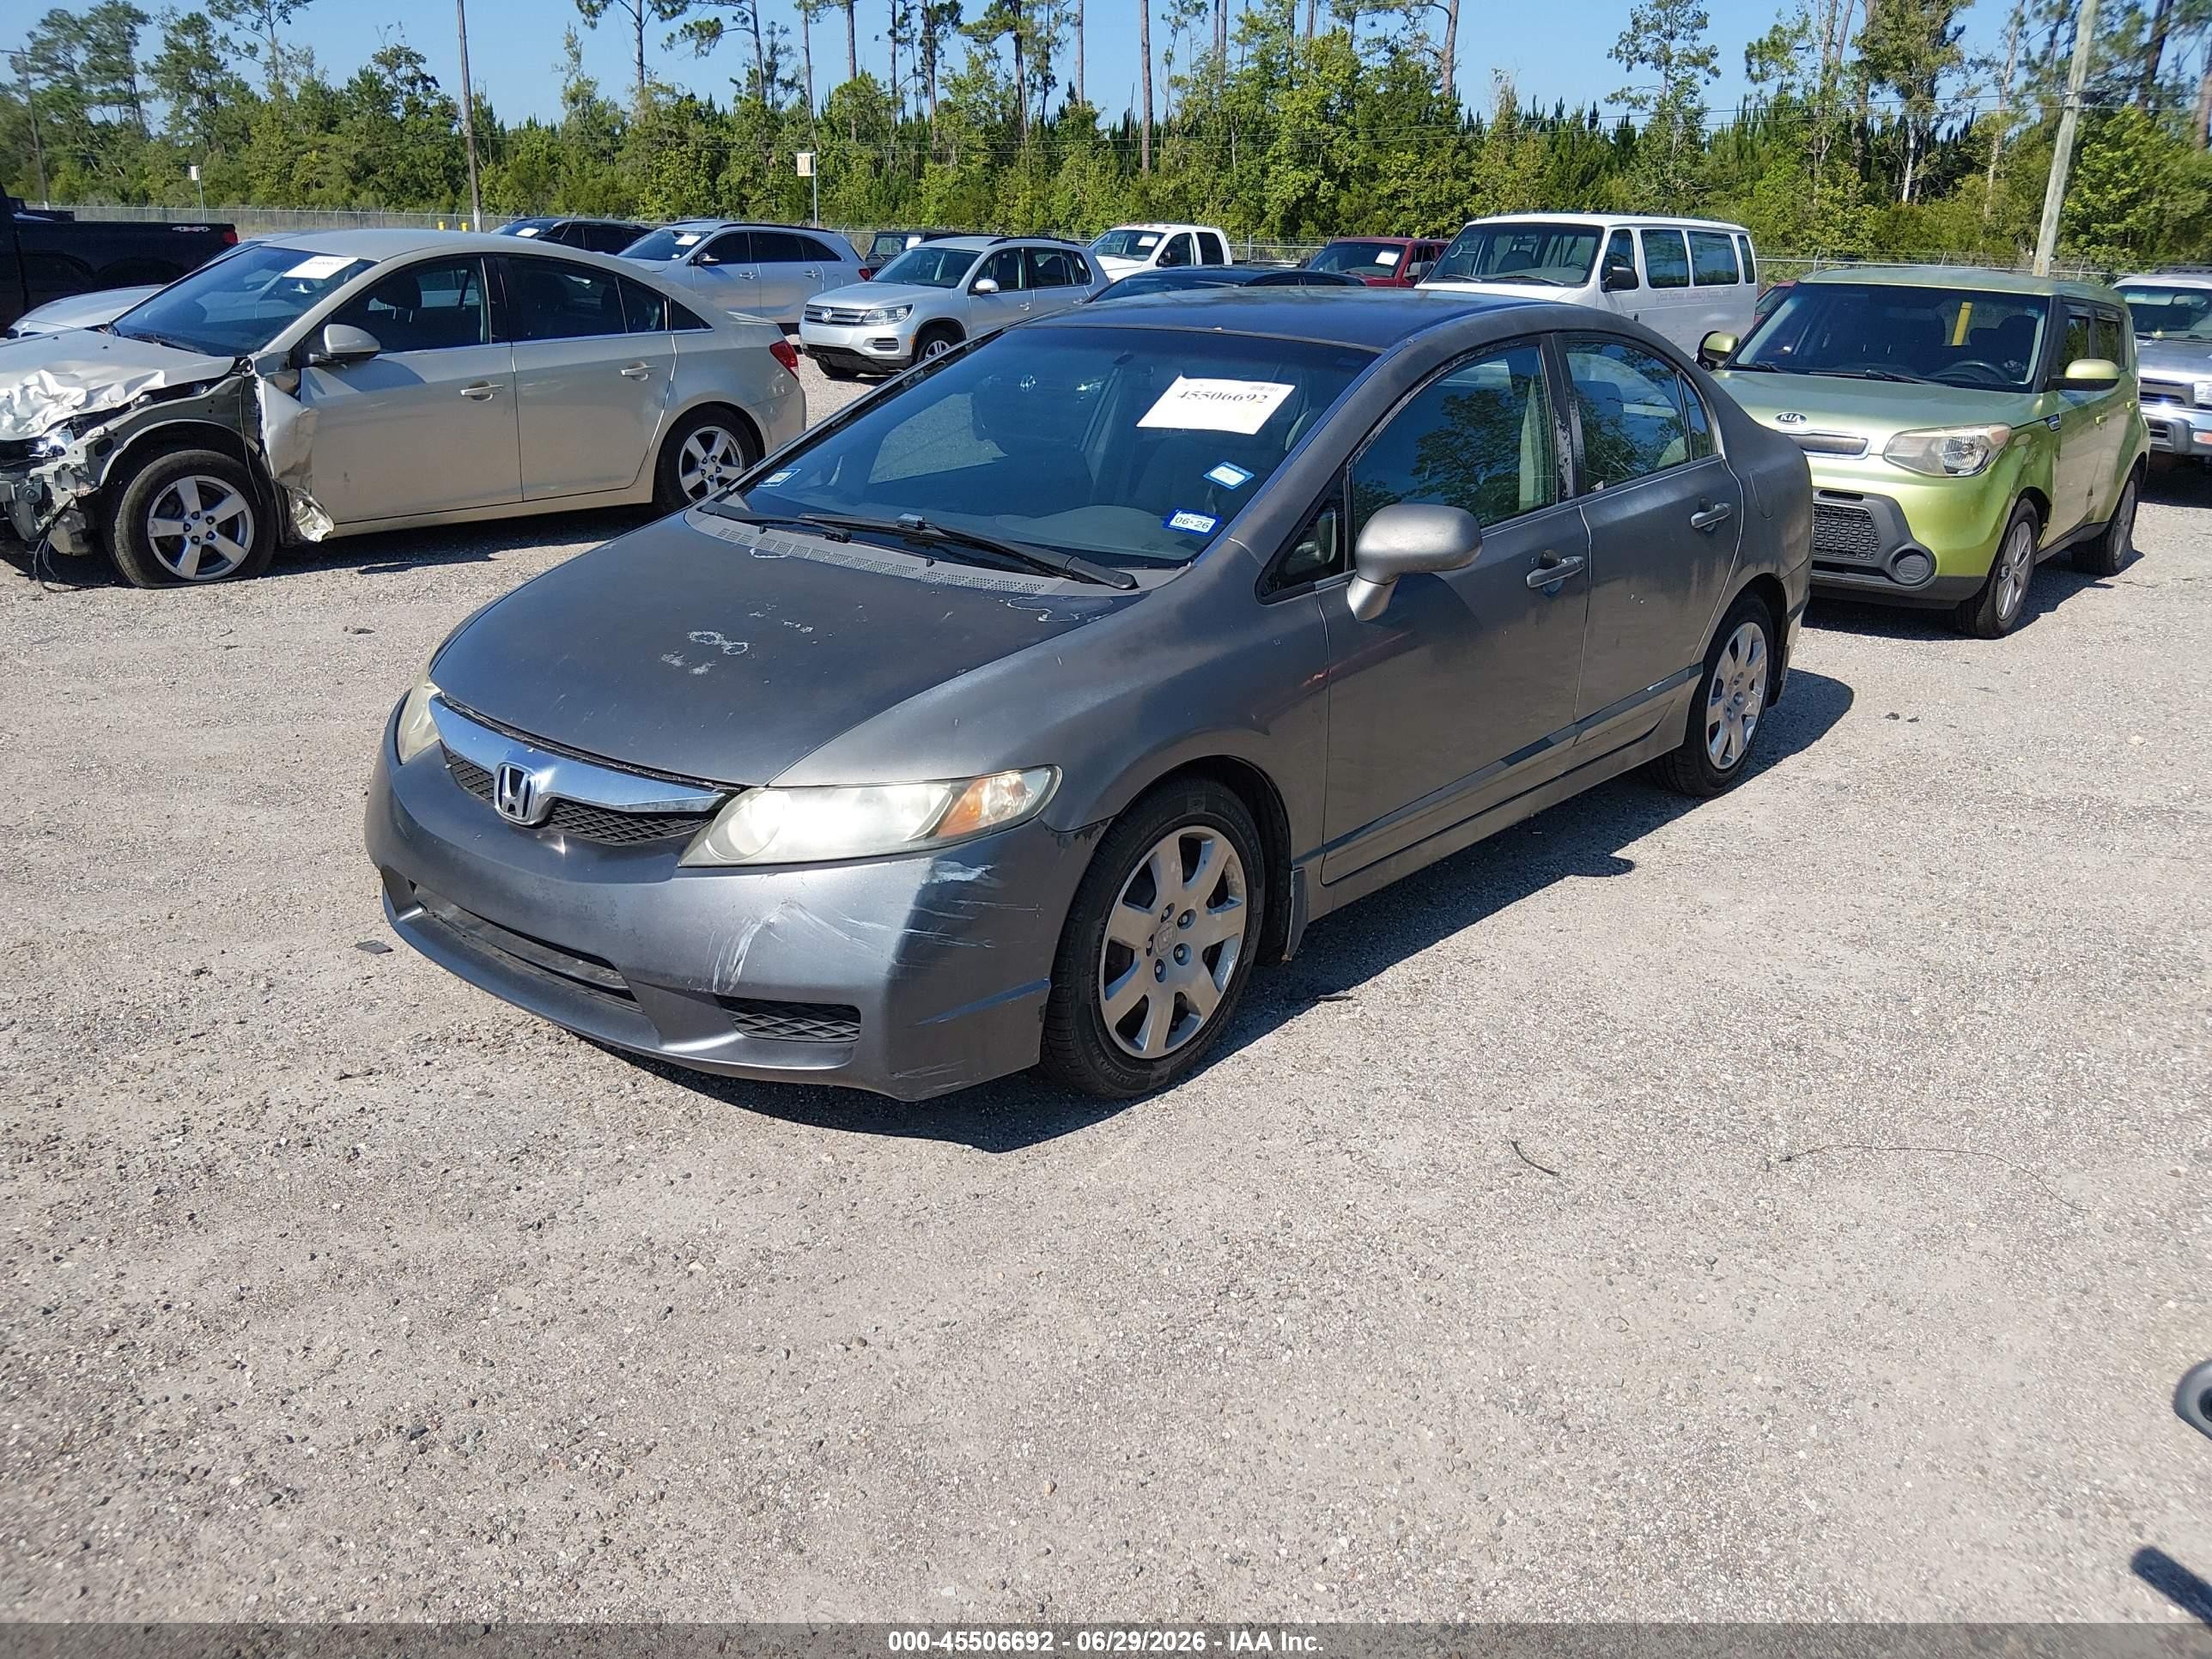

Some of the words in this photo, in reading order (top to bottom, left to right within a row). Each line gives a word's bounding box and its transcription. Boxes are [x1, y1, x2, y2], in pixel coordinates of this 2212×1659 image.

[798, 156, 810, 173] 20
[1176, 390, 1269, 404] 45506692
[1780, 413, 1802, 423] KIA
